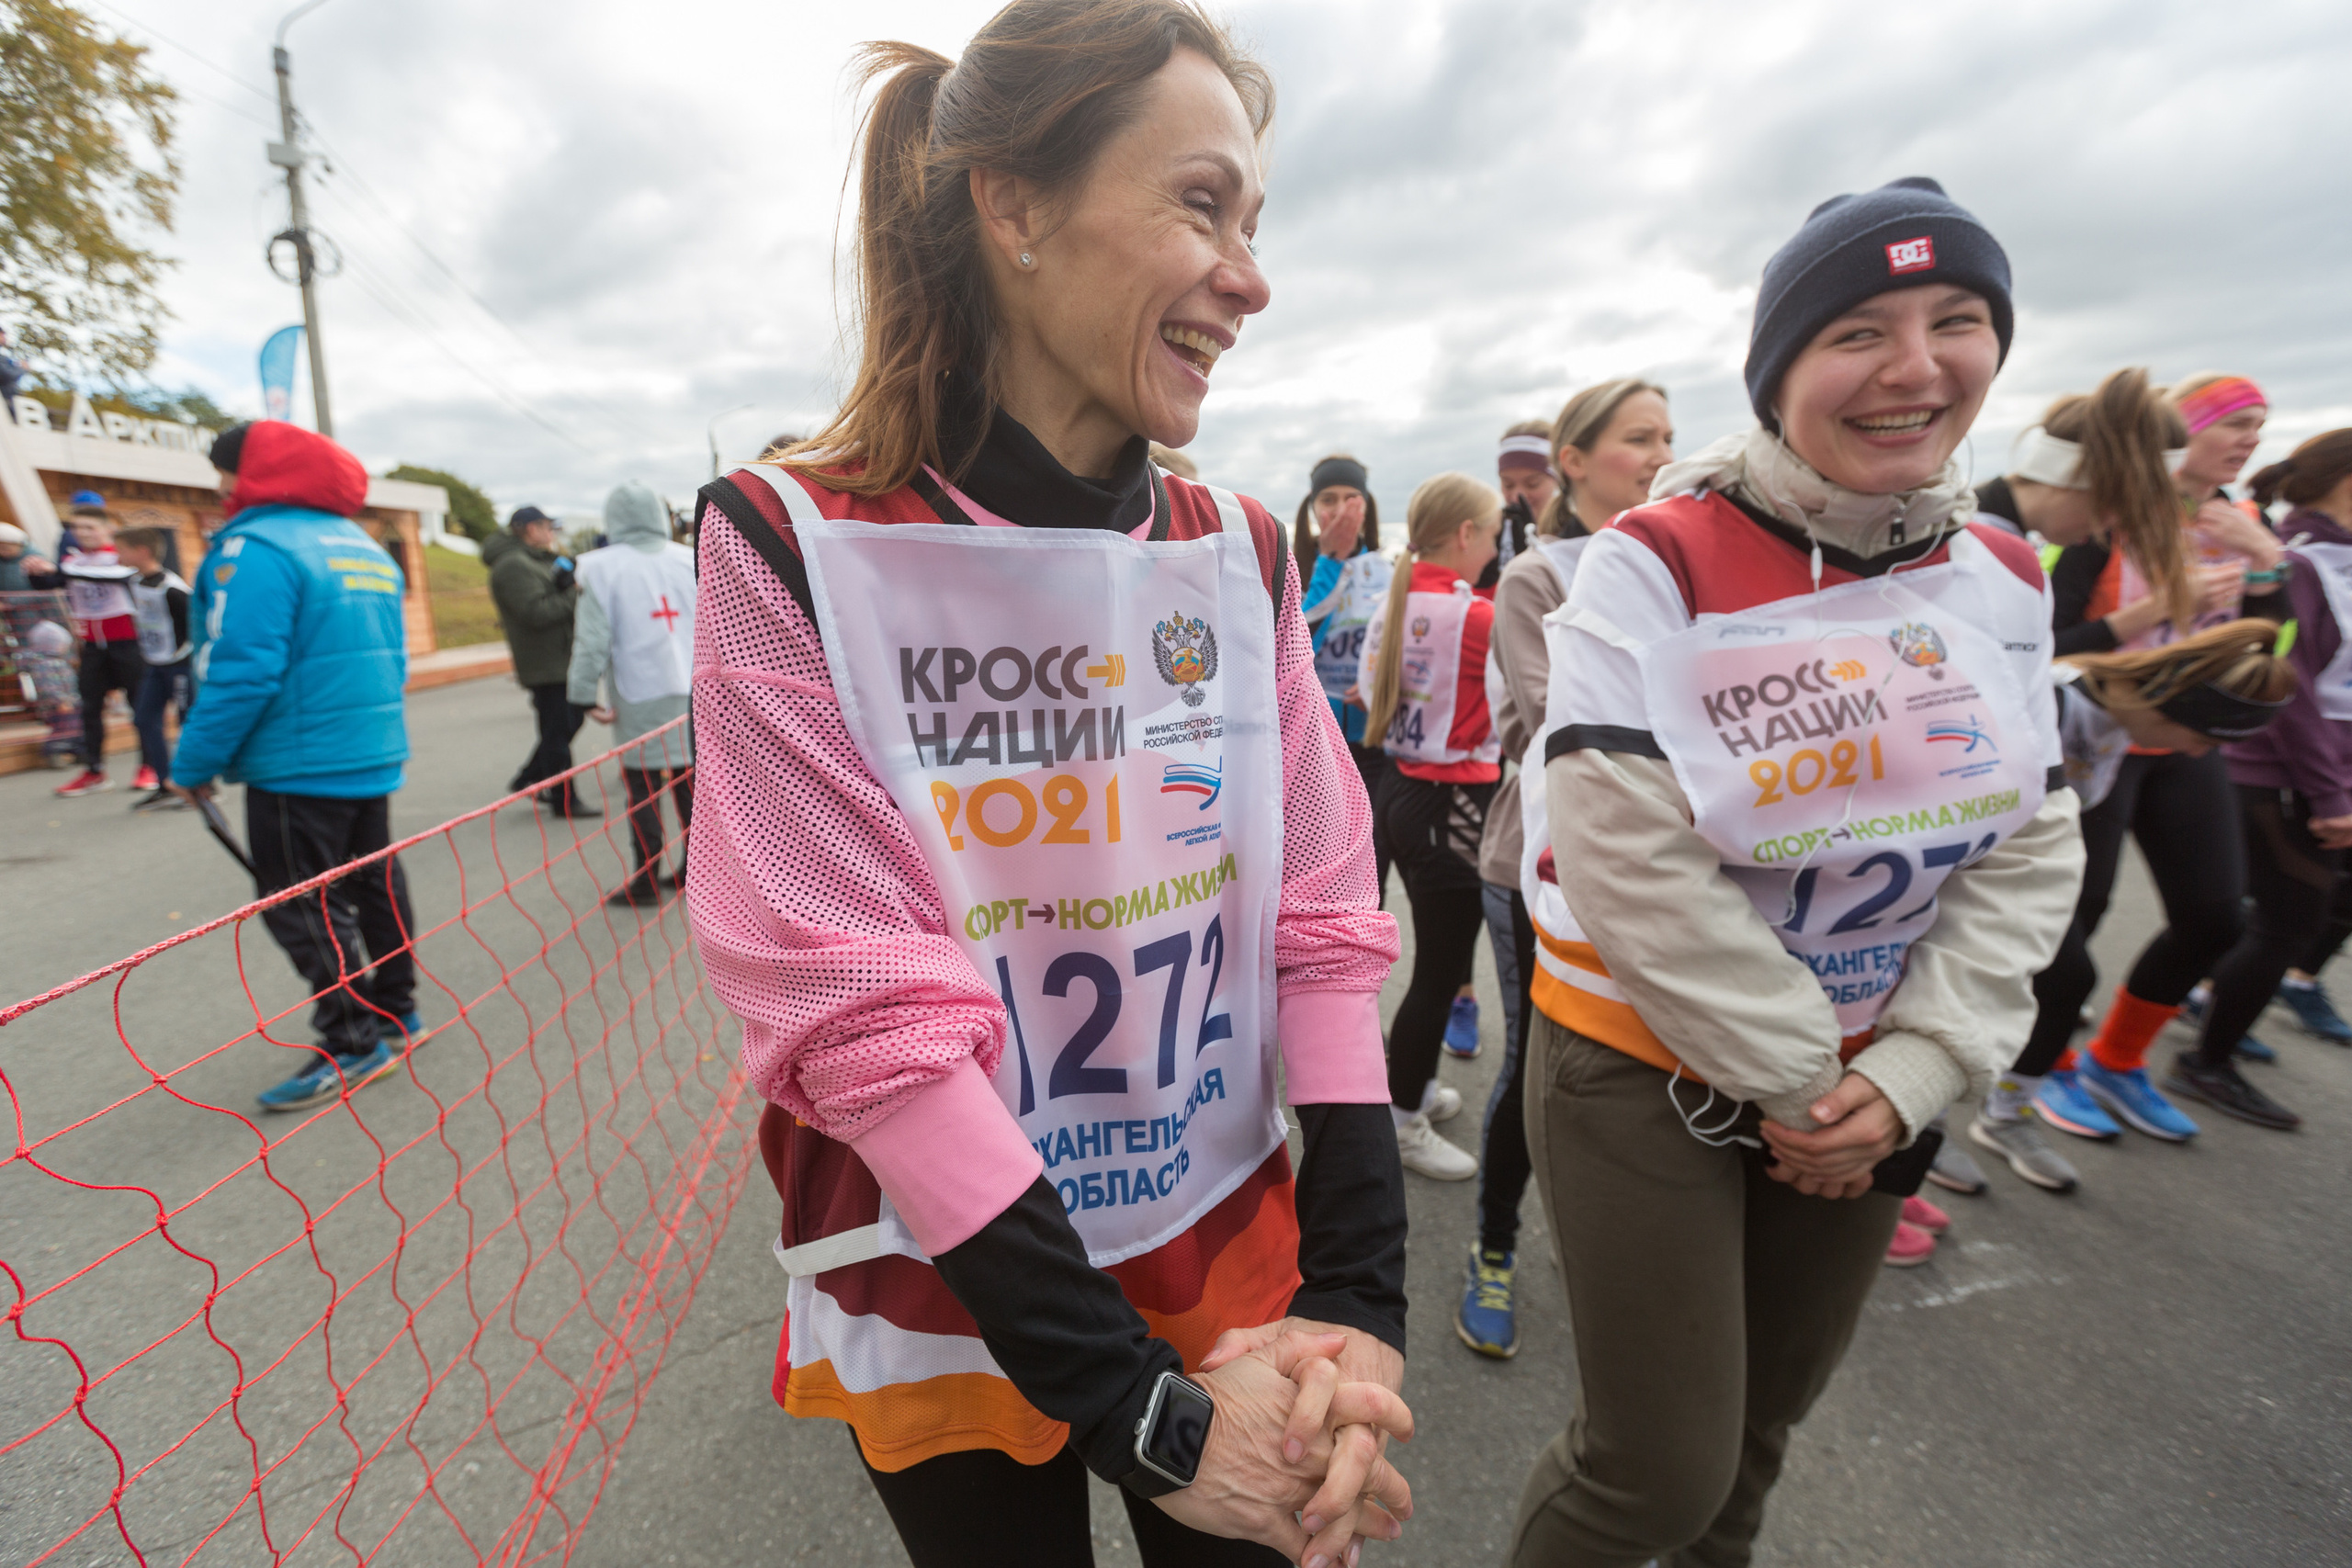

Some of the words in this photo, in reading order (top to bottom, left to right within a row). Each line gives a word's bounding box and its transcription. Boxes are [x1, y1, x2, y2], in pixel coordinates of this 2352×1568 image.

[899, 645, 1089, 703] КРОСС
[1702, 659, 1837, 728] КРОСС
[907, 705, 1125, 768] НАЦИИ
[1144, 730, 1202, 749] РОССИЙСКОЙ
[1203, 728, 1223, 739] ФЕДЕ
[1146, 717, 1212, 736] МИНИСТЕРСТВО
[1718, 689, 1889, 757] НАЦИИ
[1749, 733, 1885, 808] 2021
[930, 773, 1122, 852] 2021
[1167, 823, 1217, 841] ВСЕРОССИЙСКАЯ
[1185, 834, 1208, 846] ЛЕГКОЙ
[1753, 828, 1834, 863] СПОРТ
[1849, 803, 1955, 840] НОРМА
[965, 898, 1029, 941] СОРТ
[1058, 886, 1170, 930] НОРМА
[1170, 852, 1238, 908] ЖИЗИ
[1774, 832, 1997, 937] 127
[996, 912, 1233, 1117] 1272
[1032, 1067, 1226, 1168] ХАНГЕЛЬСКАЯ
[1057, 1145, 1190, 1215] ОБЛАСТЬ
